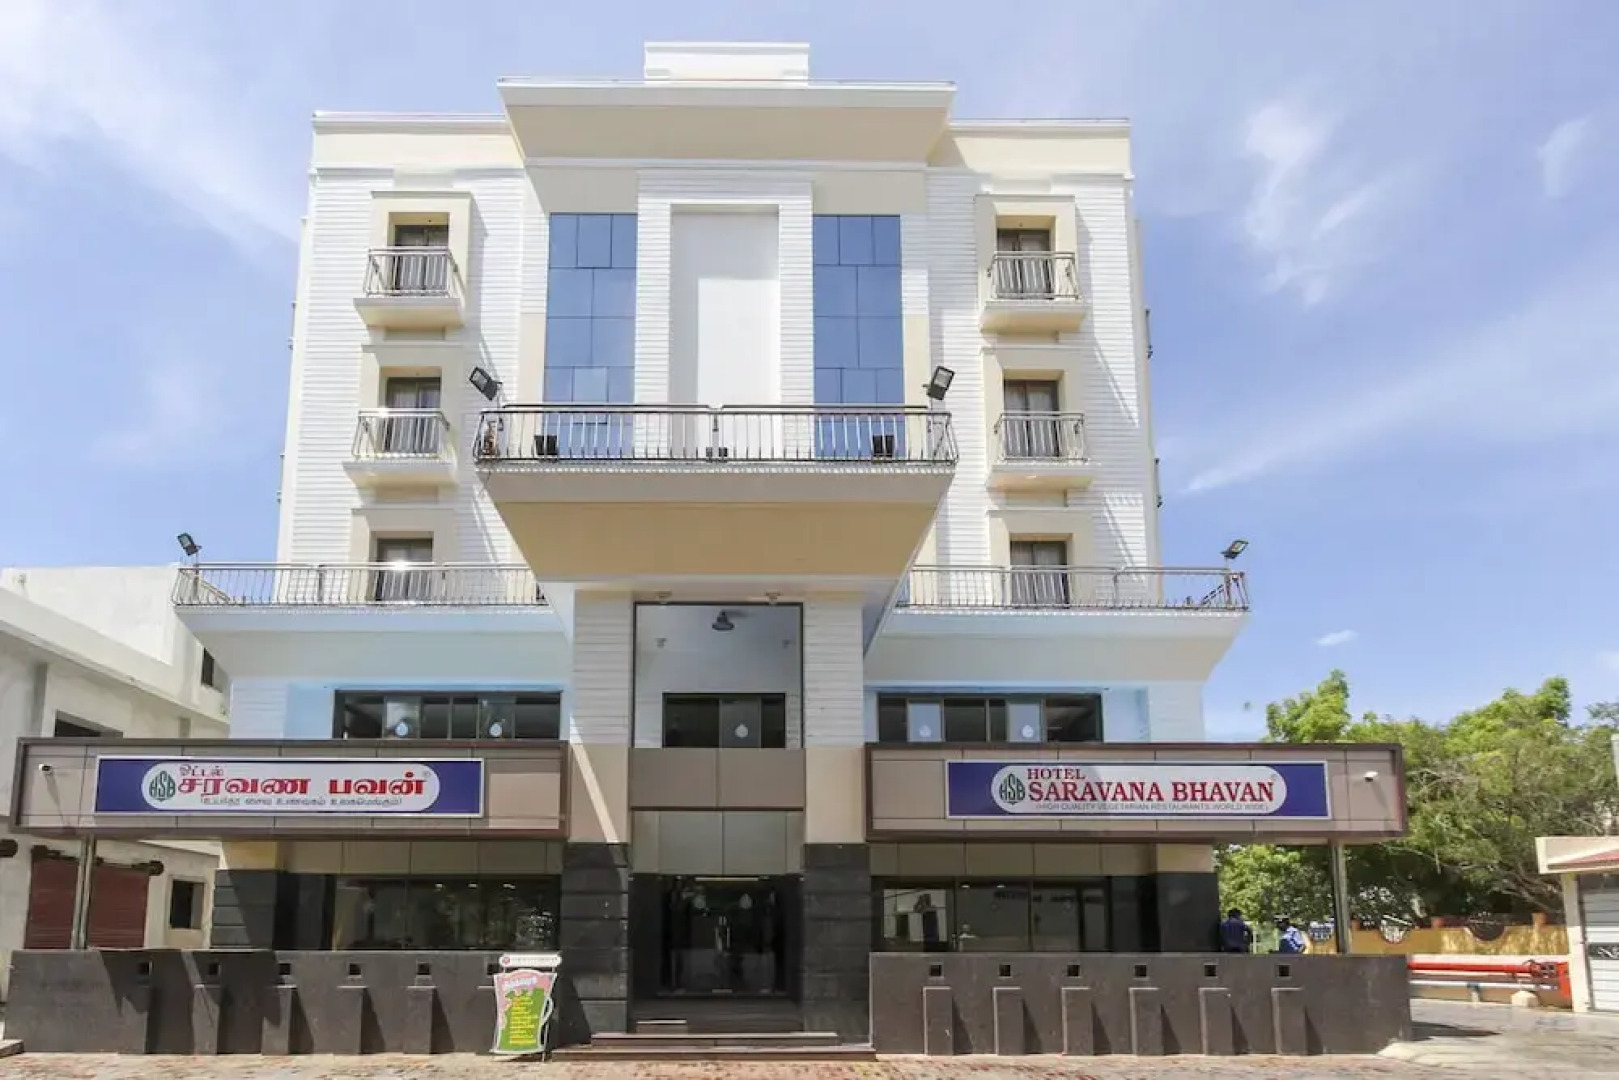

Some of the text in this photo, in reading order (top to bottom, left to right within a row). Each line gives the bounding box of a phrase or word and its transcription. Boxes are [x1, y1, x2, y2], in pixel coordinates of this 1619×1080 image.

[178, 771, 426, 796] சரவண பவன்
[1027, 768, 1086, 780] HOTEL
[999, 773, 1026, 805] HSB
[1029, 781, 1275, 802] SARAVANA BHAVAN
[1062, 802, 1095, 811] QUALITY
[1099, 802, 1149, 811] VEGETARIAN
